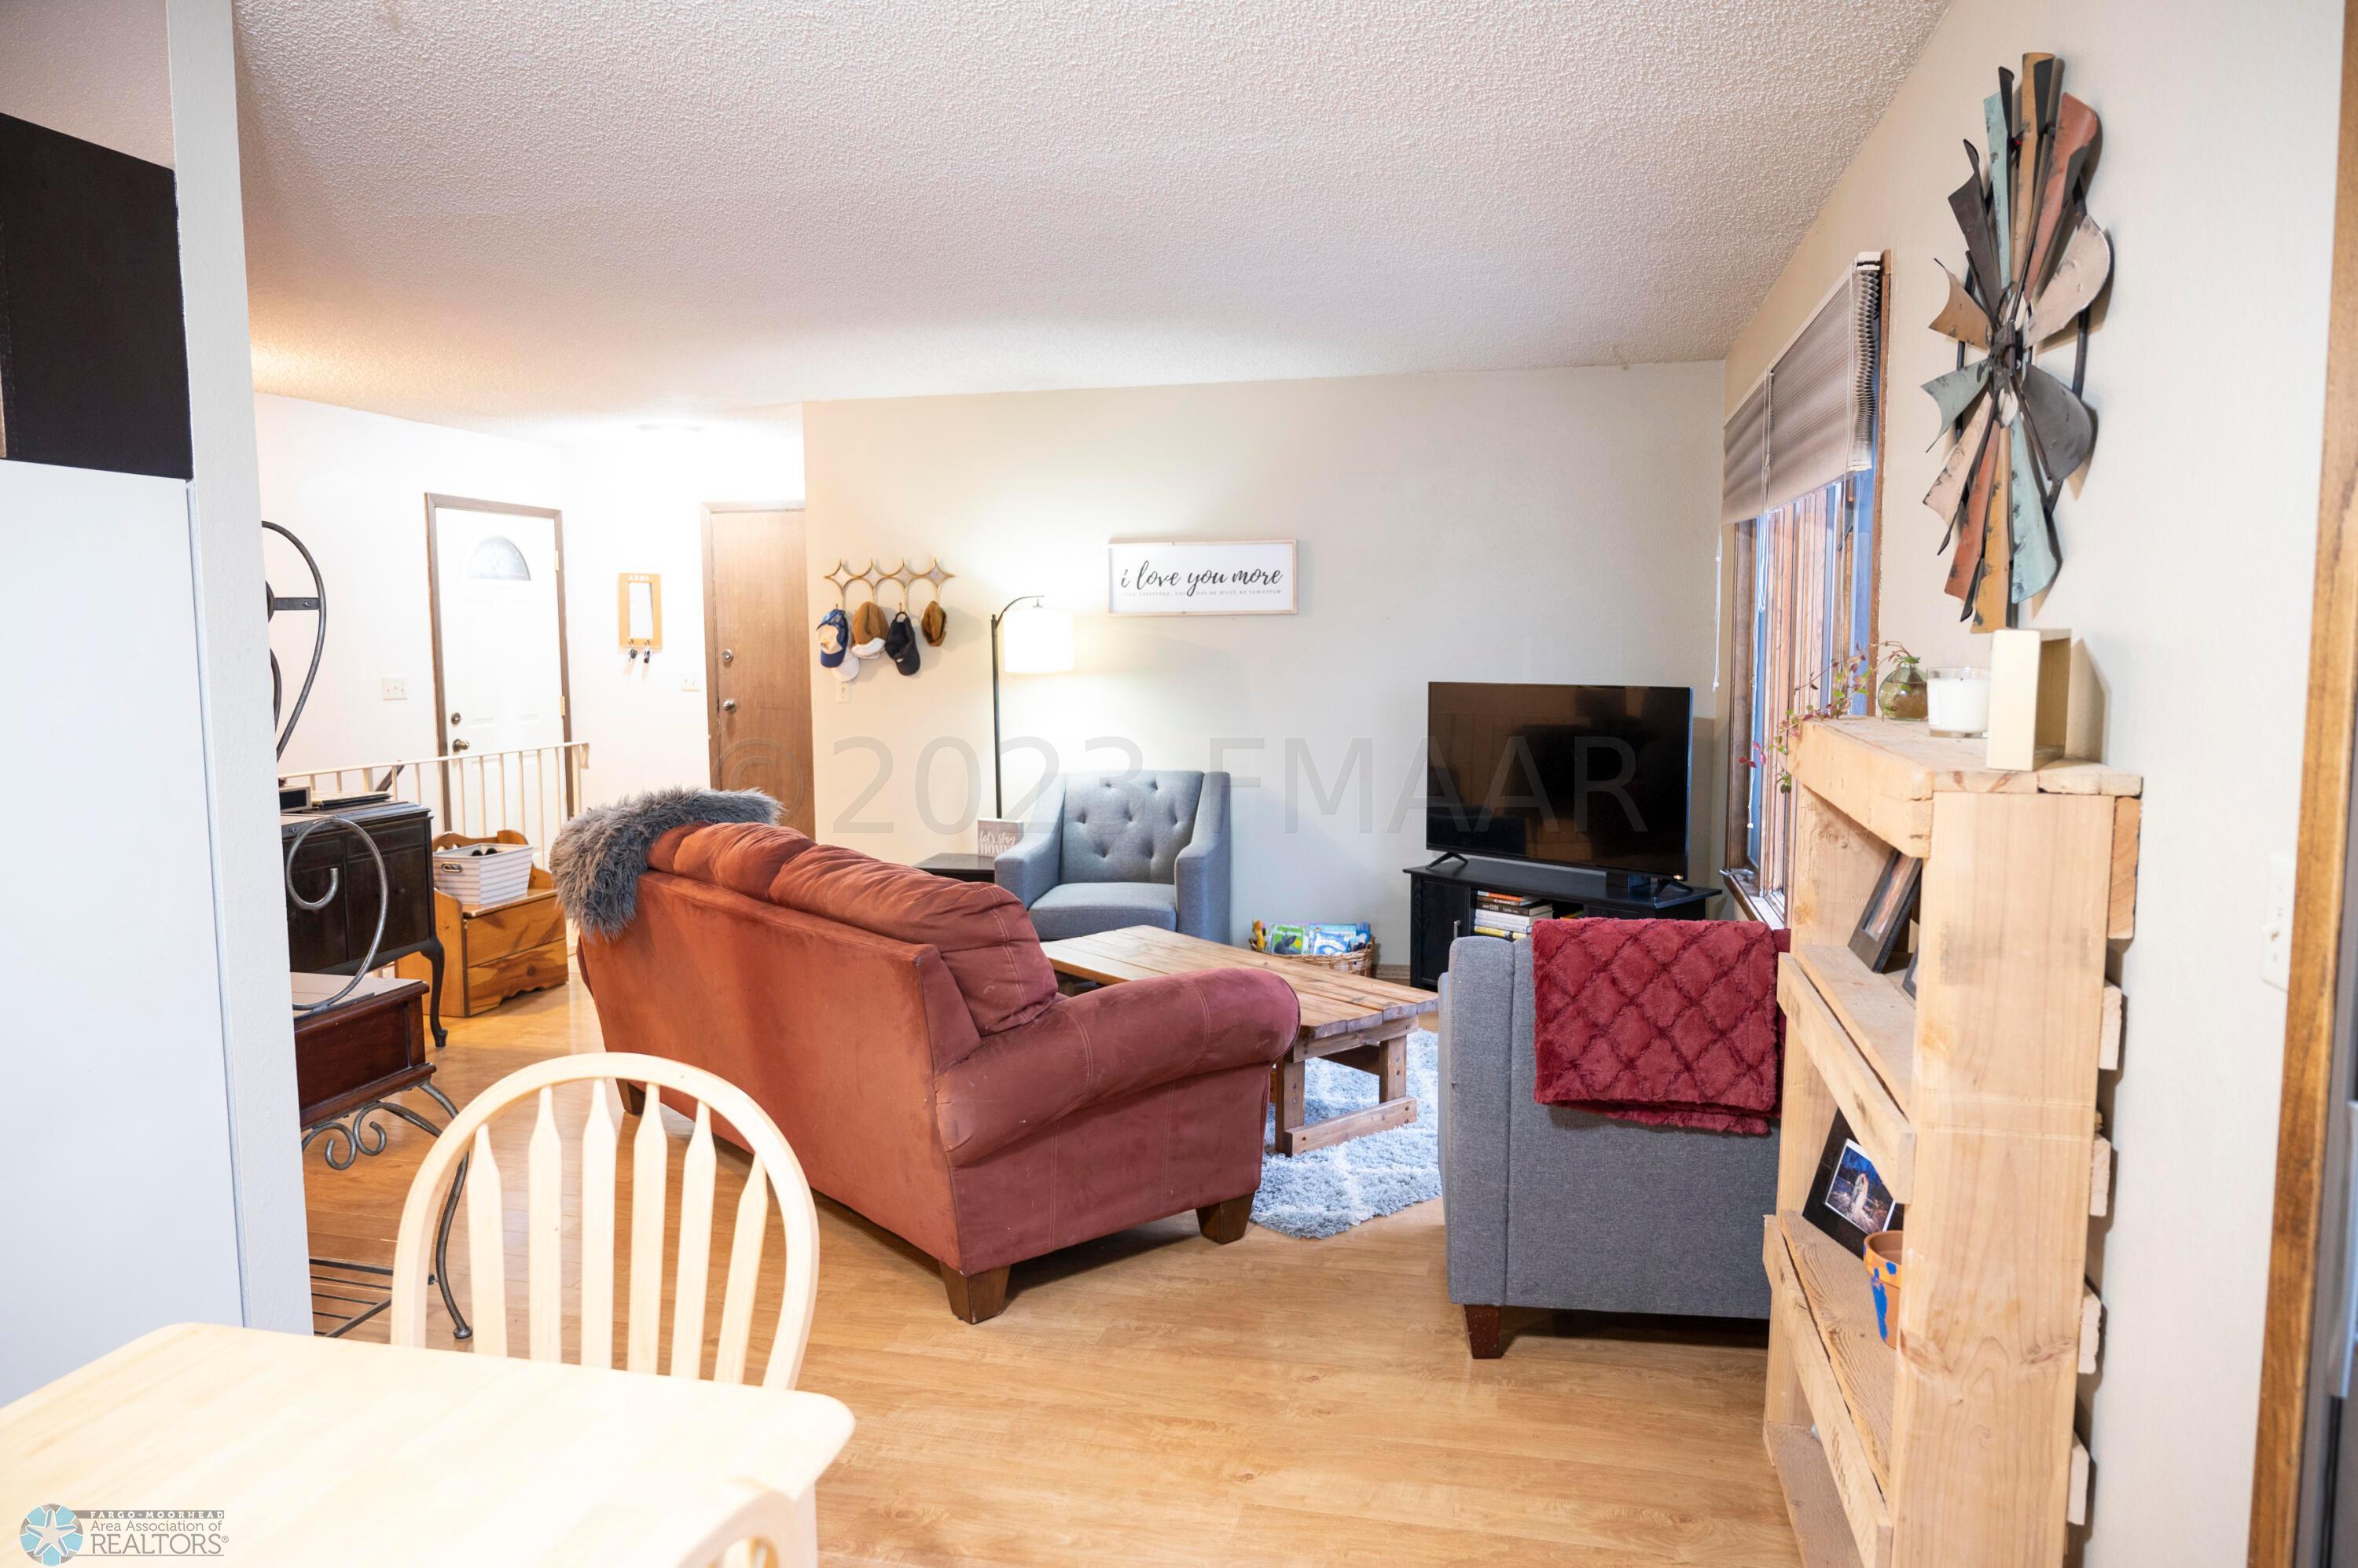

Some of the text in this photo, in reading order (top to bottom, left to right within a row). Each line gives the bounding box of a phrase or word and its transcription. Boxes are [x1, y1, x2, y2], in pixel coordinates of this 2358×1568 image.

[1121, 560, 1284, 597] i love you more
